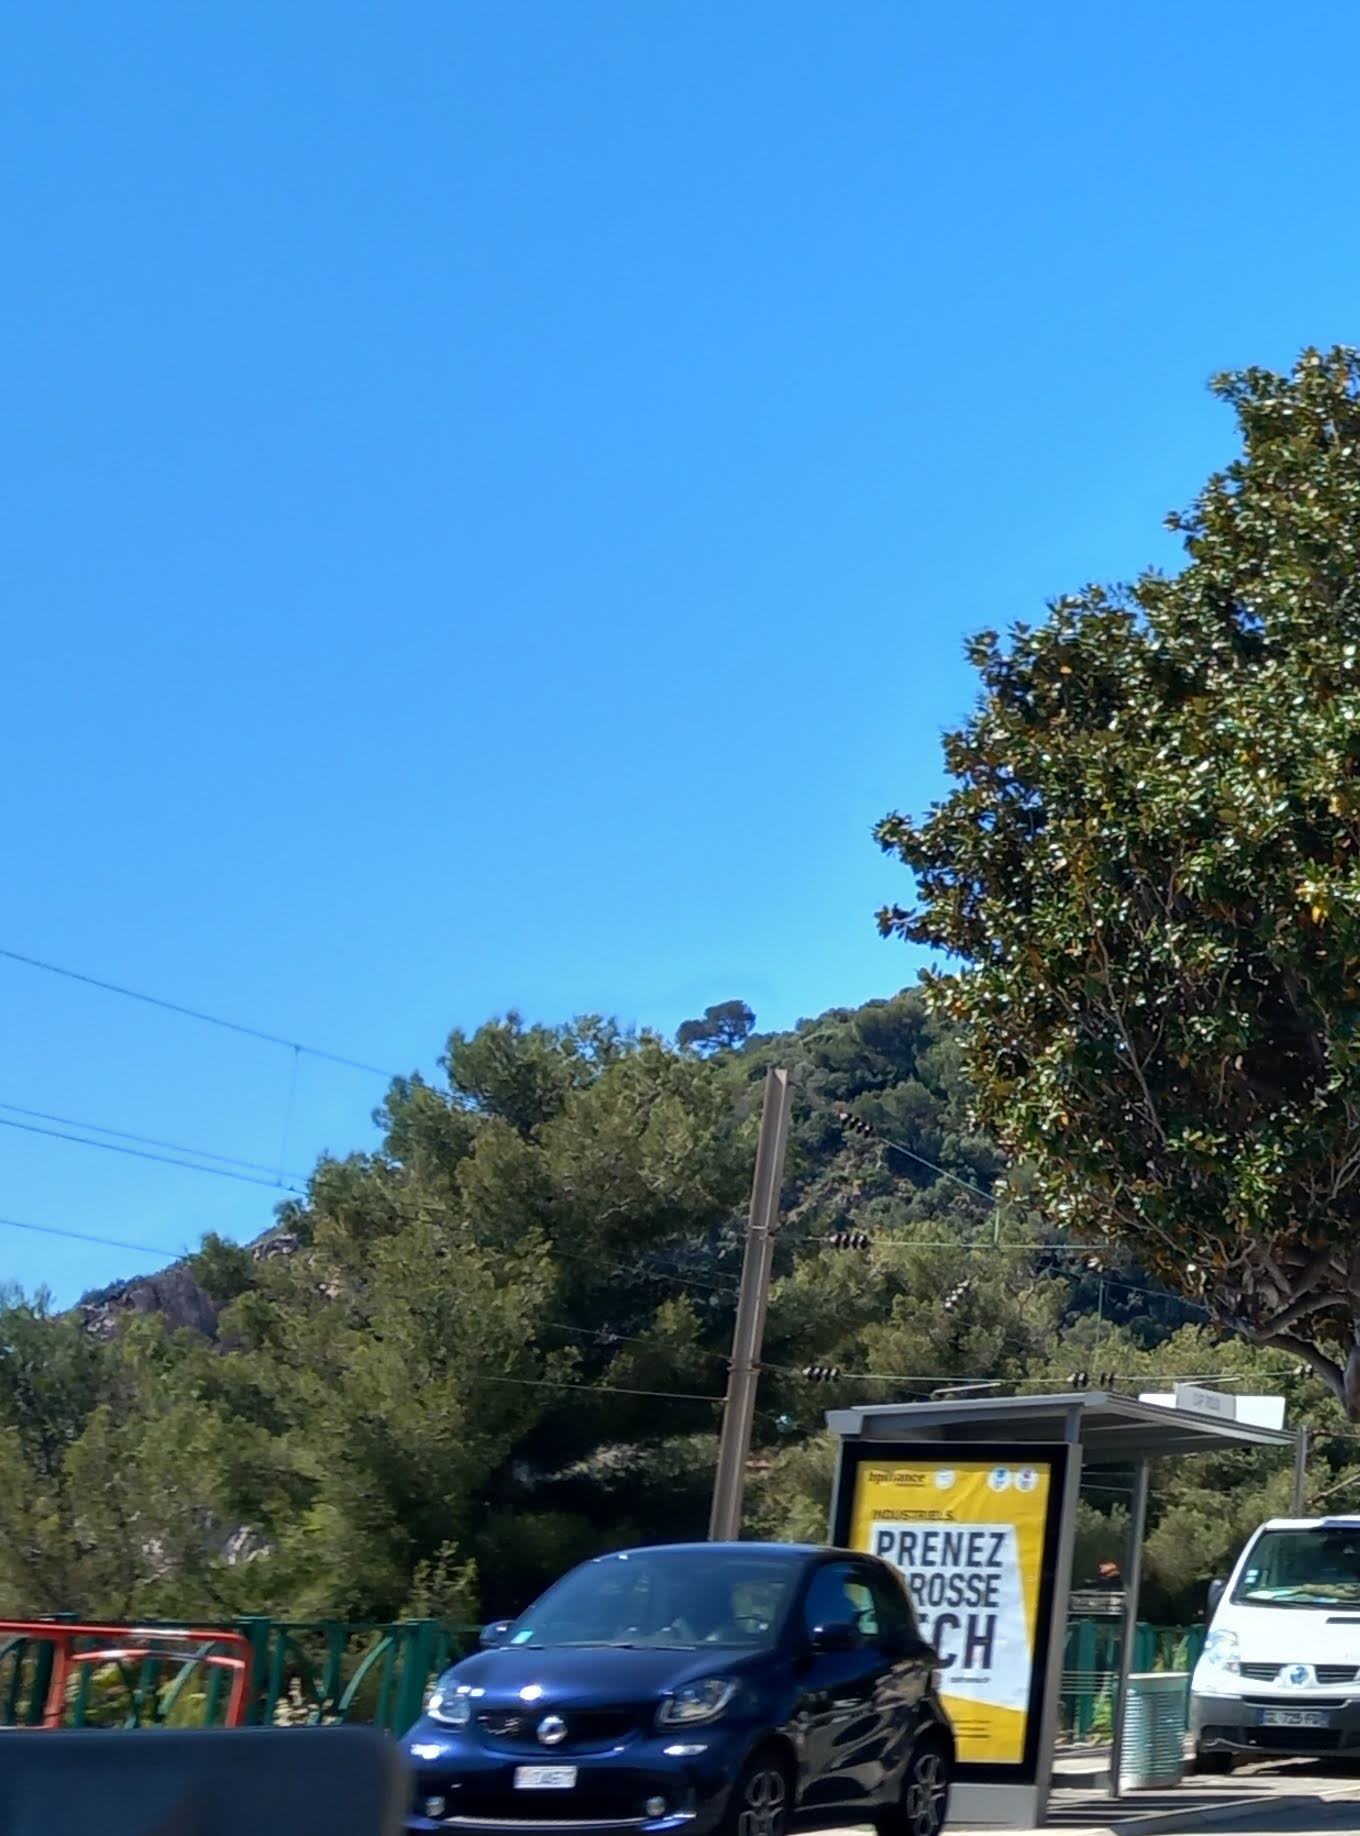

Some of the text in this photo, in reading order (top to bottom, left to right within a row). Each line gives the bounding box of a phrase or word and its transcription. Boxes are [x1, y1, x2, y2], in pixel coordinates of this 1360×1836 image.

[877, 1530, 1007, 1567] PRENEZ
[909, 1572, 1002, 1608] ROSSE
[918, 1613, 998, 1670] CH
